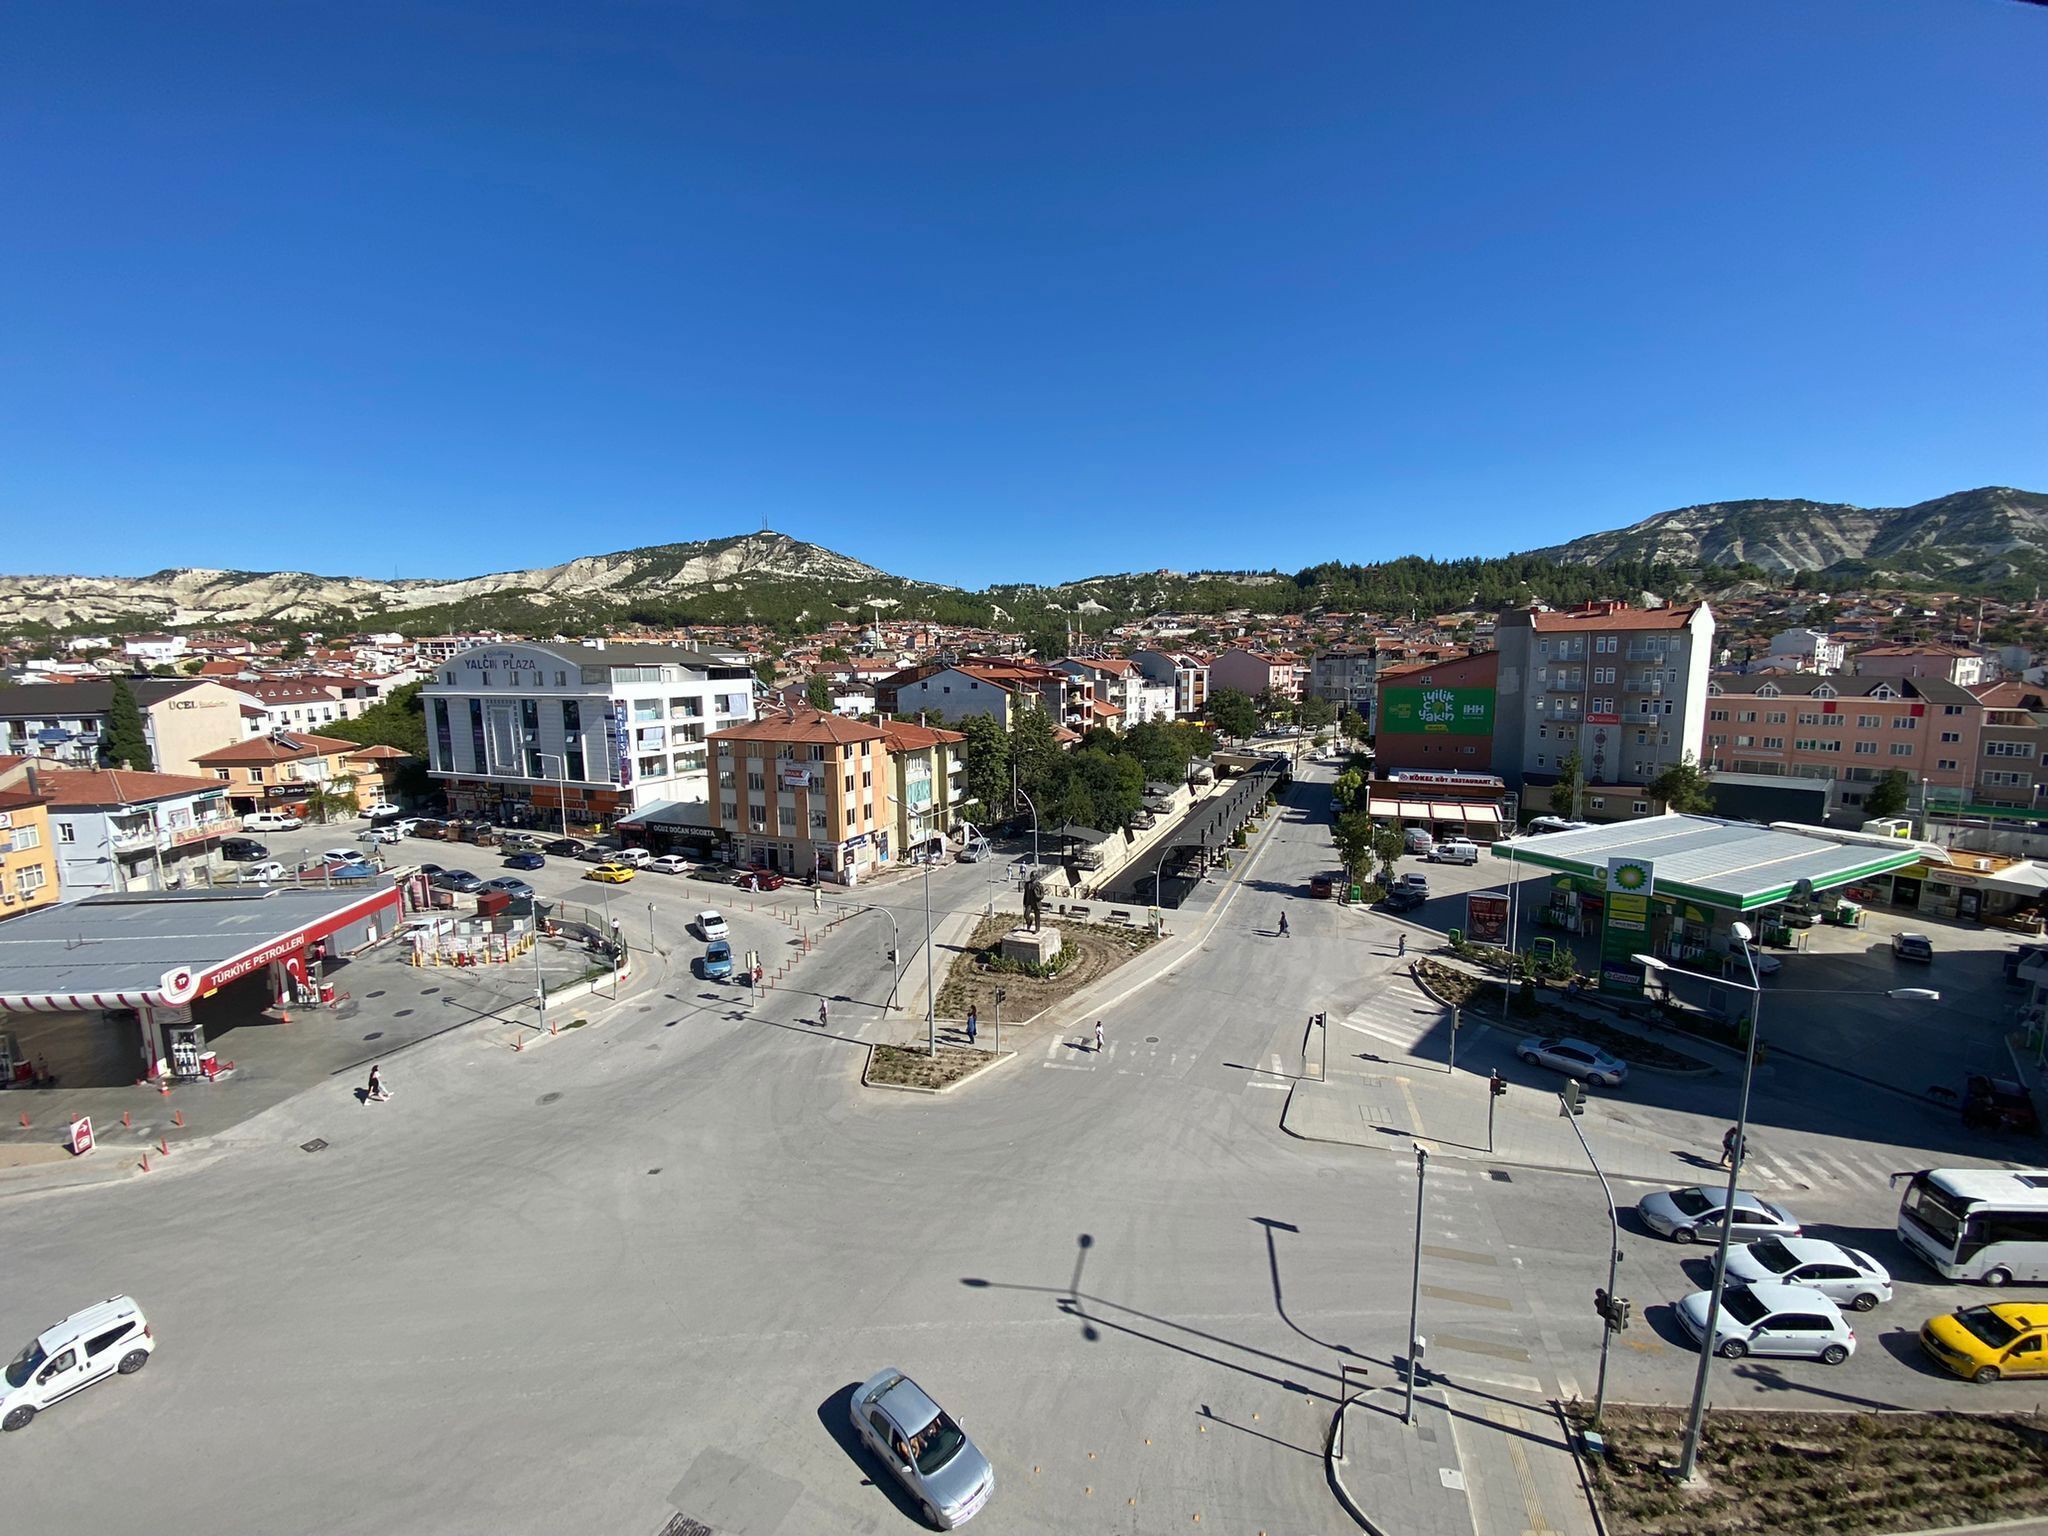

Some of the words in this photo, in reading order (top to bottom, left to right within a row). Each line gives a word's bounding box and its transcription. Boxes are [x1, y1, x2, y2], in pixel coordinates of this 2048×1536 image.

[503, 659, 536, 670] PLAZA
[210, 961, 253, 986] TÜRKİYE
[253, 933, 305, 967] PETROLLERİ
